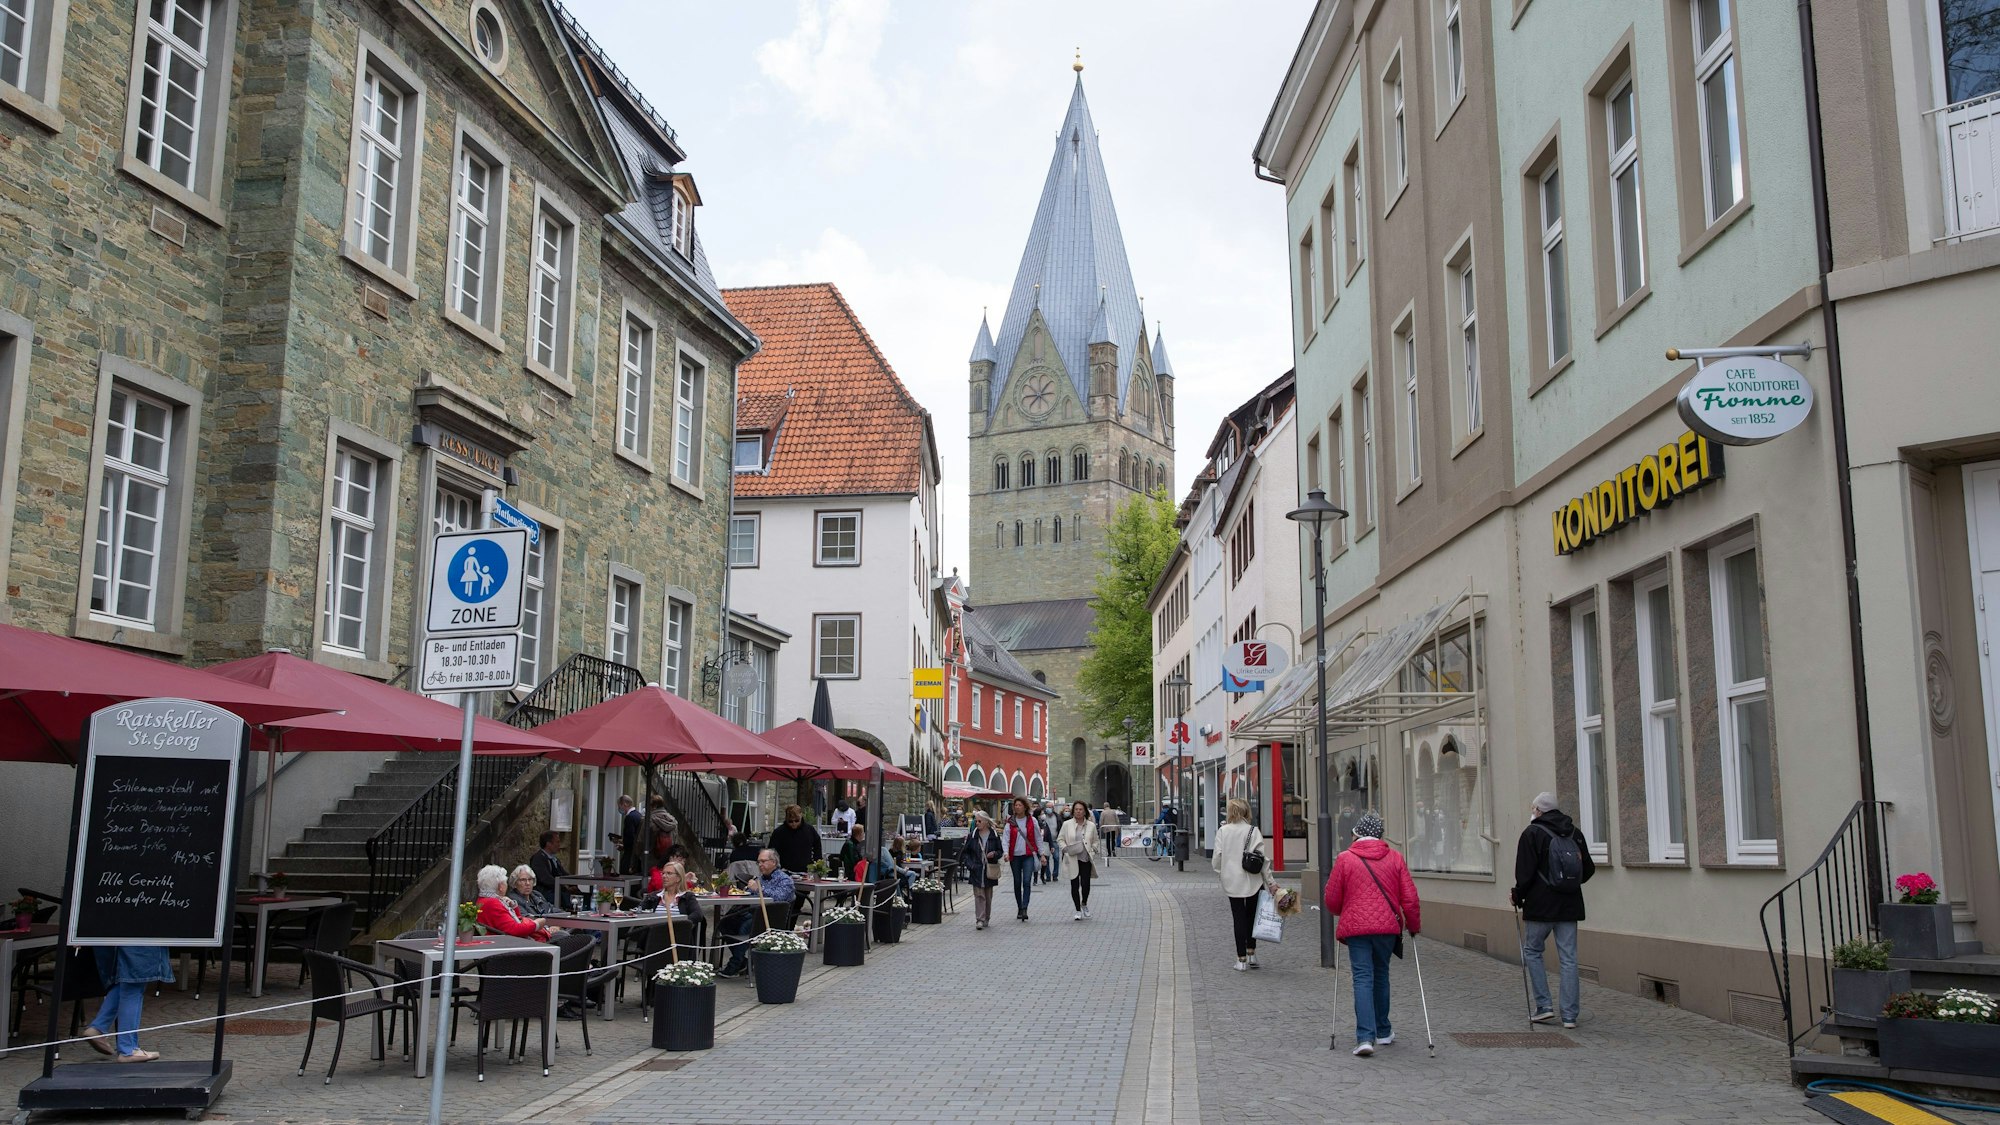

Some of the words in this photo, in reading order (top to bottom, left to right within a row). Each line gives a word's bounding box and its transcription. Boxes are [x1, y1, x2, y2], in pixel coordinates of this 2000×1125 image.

[1726, 369, 1756, 379] CAFE
[1728, 380, 1799, 392] KONDITOREI
[1696, 388, 1805, 411] Fromme
[1731, 417, 1747, 425] SEIT
[1748, 413, 1776, 424] 1852
[440, 431, 500, 472] RESSOURCE
[1552, 430, 1710, 556] KONDITOREI
[451, 606, 497, 625] ZONE
[434, 642, 449, 653] Be-
[452, 641, 467, 652] und
[469, 640, 505, 651] Entladen
[449, 673, 463, 683] frei
[116, 709, 218, 733] Ratskeller
[102, 820, 134, 834] Sauce
[98, 872, 123, 886] Alle
[128, 873, 174, 889] Gerichte
[160, 891, 191, 909] Haus
